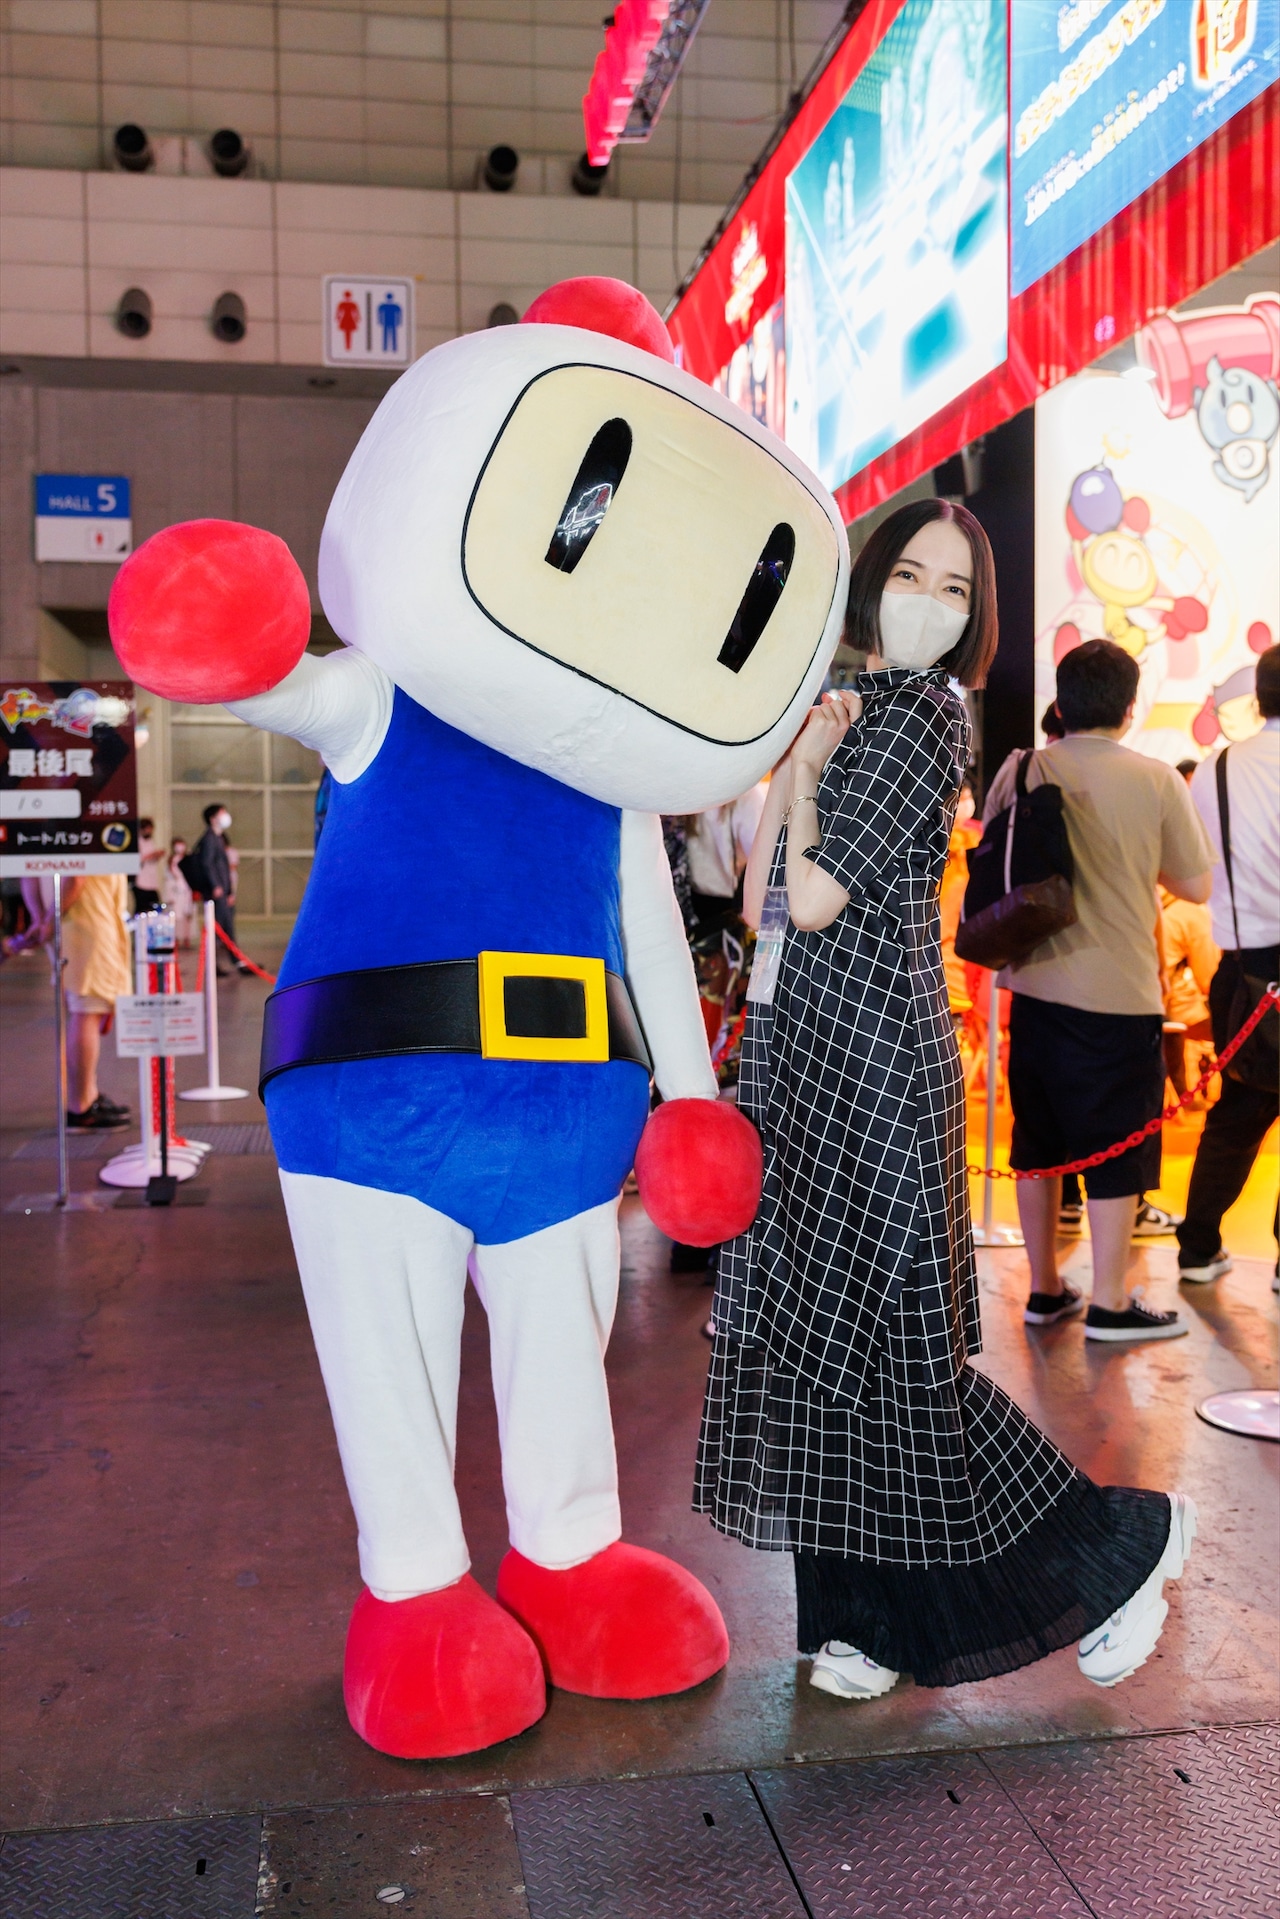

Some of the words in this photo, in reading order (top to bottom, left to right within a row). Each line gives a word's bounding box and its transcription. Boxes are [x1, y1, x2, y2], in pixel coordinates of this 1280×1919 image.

[48, 495, 93, 512] HALL
[97, 483, 117, 512] 5
[8, 748, 94, 777] 最後尾
[88, 800, 129, 816] 分待ち
[24, 860, 86, 871] KONAMI
